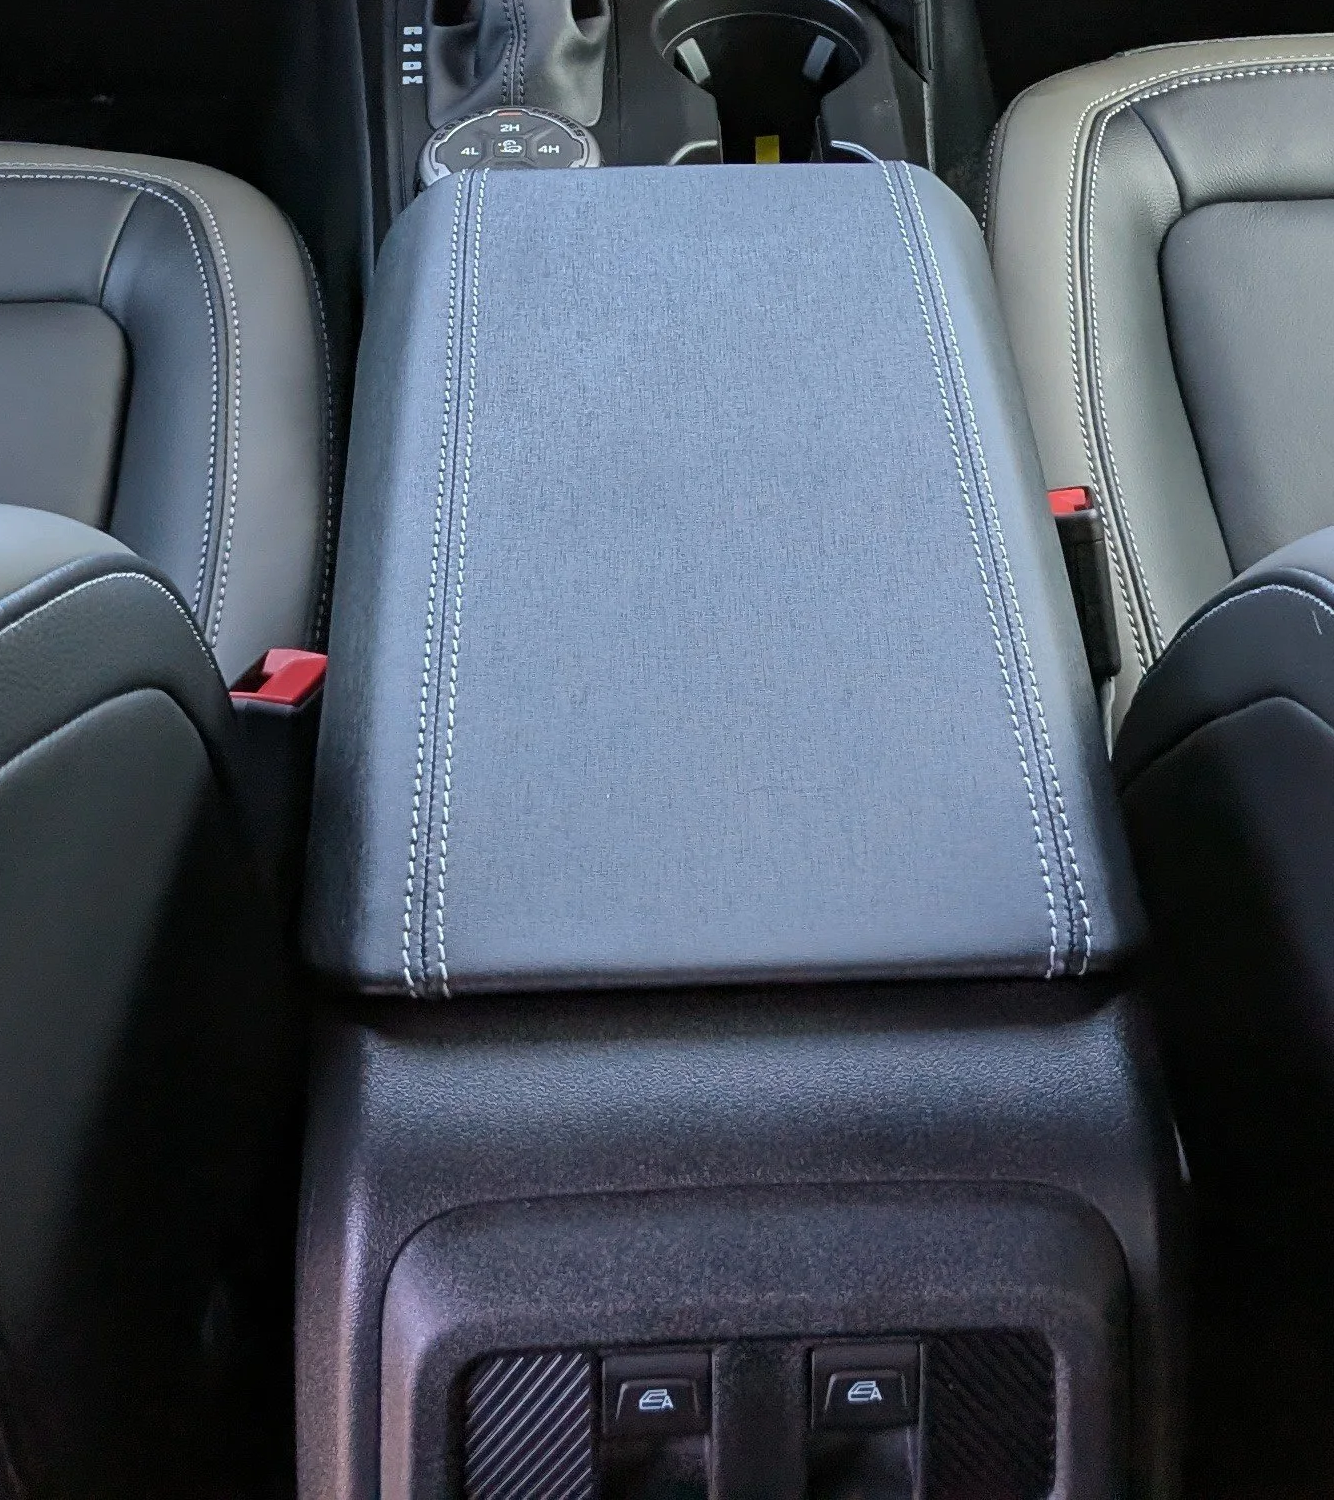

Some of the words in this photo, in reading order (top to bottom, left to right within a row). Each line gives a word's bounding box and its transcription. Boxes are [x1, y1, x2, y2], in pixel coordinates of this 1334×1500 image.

[403, 43, 423, 53] N
[402, 75, 423, 85] M
[500, 124, 520, 132] 2H
[460, 147, 480, 155] 4L
[538, 145, 560, 154] 4H
